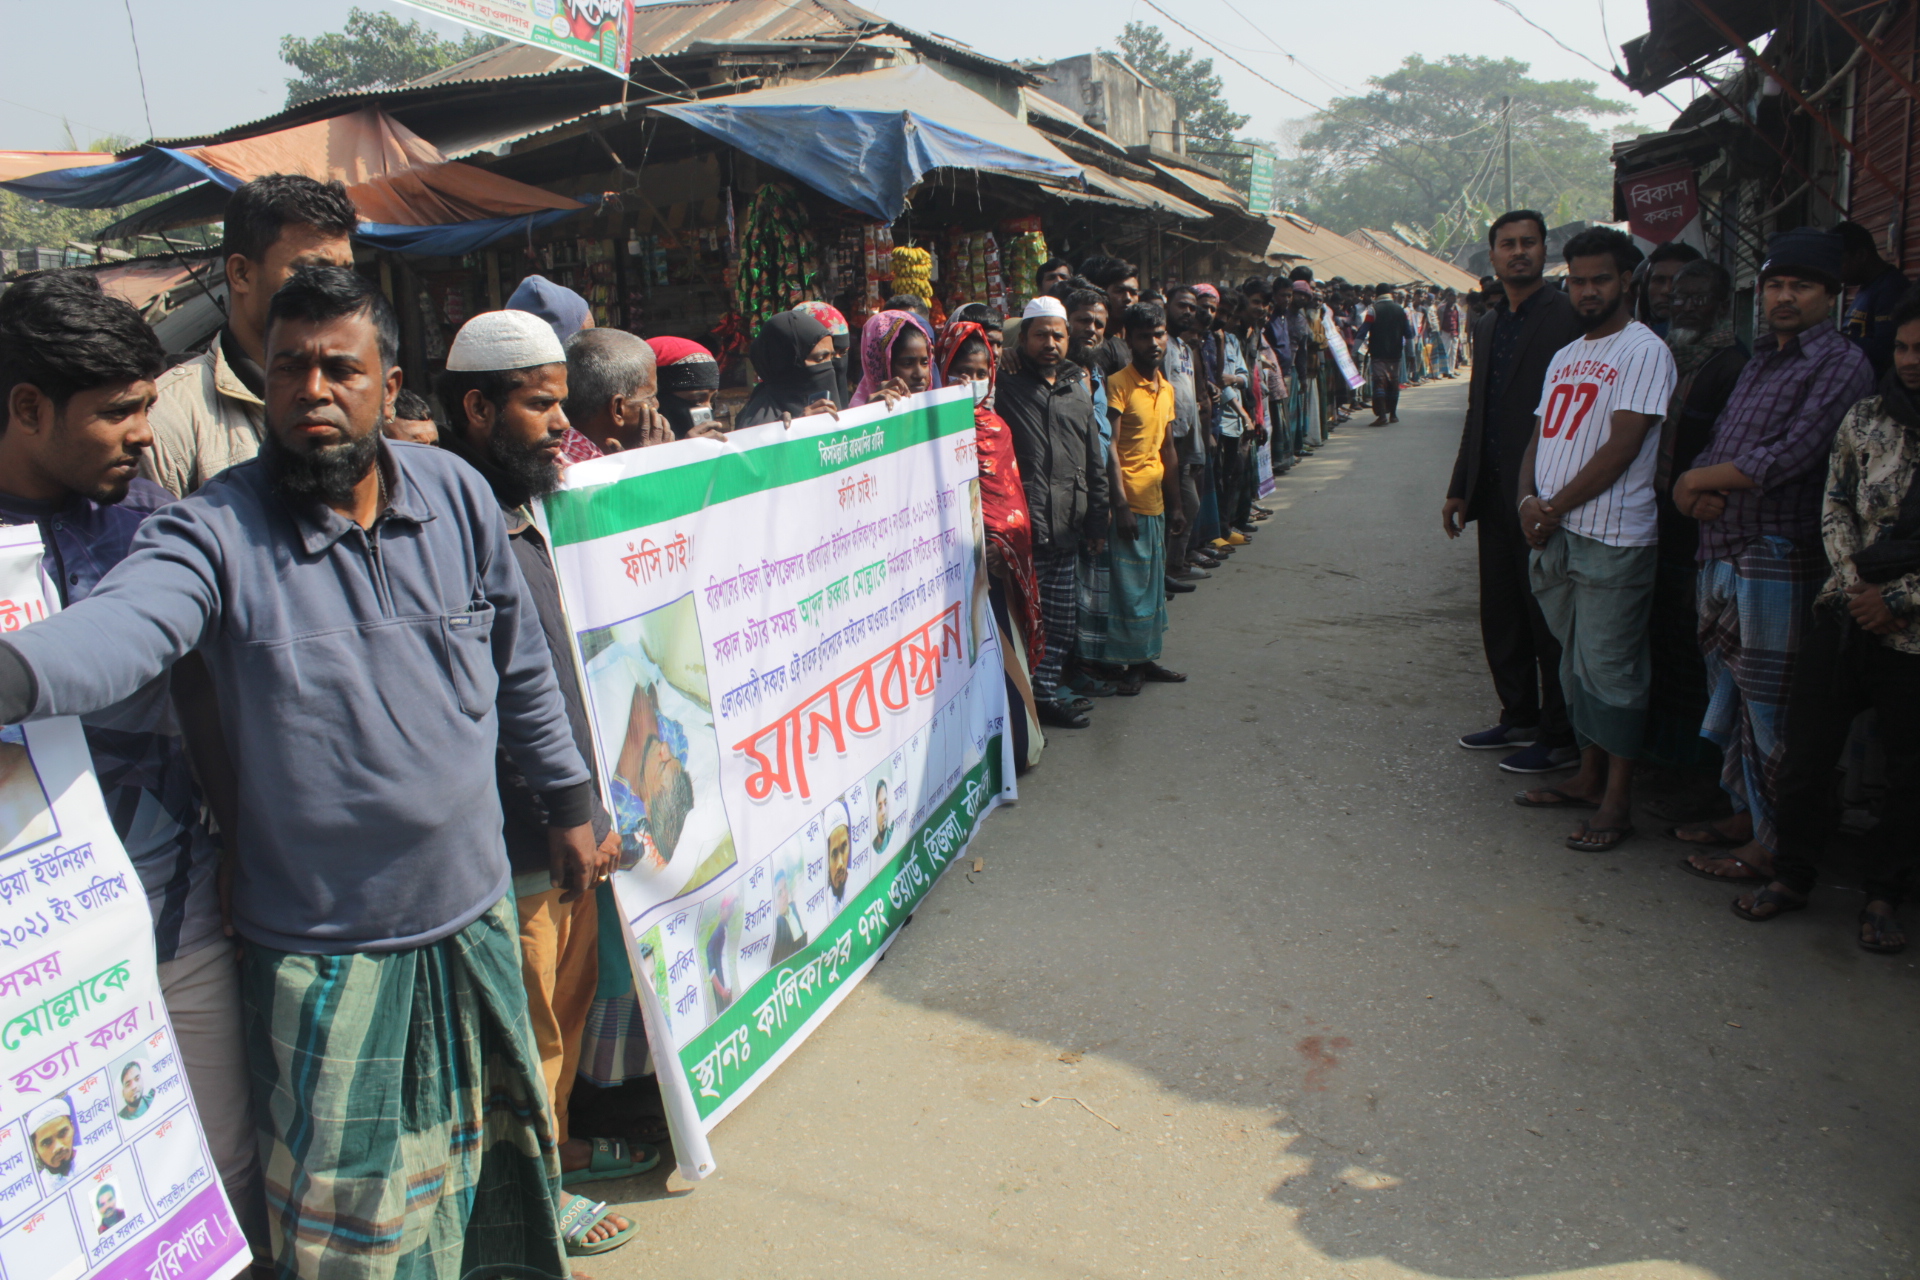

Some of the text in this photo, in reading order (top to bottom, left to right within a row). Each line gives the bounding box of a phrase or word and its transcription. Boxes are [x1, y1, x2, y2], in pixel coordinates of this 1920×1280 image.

[1630, 179, 1689, 208] বিকাশ
[1643, 205, 1684, 225] করুন
[1551, 360, 1619, 386] SWAGGER
[1542, 382, 1599, 441] 07
[838, 475, 856, 512] ফাঁসি
[620, 530, 695, 587] ফাঁসি চাই!!
[704, 574, 740, 613] বরিশালের
[738, 563, 764, 601] হিজলা
[760, 553, 805, 588] উপজেলার
[713, 631, 742, 667] সকাল
[743, 616, 770, 653] ৯টার
[769, 608, 798, 640] সময়
[825, 574, 850, 611] জব্বার
[853, 558, 886, 598] মোল্লাকে
[720, 667, 762, 718] এলাকাবাসী
[761, 664, 788, 698] সকলে
[789, 650, 801, 685] এই
[732, 600, 962, 800] মানববন্ধন
[850, 785, 862, 805] খুনি
[806, 820, 819, 842] খুনি
[28, 841, 96, 887] ইউনিয়ন
[749, 866, 764, 889] খুনি
[808, 856, 823, 882] ইমাম
[47, 897, 78, 925] ইং
[73, 871, 128, 910] তারিখে
[806, 887, 825, 914] সরদার
[666, 912, 690, 936] খুনি
[740, 934, 770, 961] সরদার
[751, 928, 853, 1038] কালিকাপুর
[859, 898, 889, 945] ৭নং
[887, 840, 930, 910] ওয়ার্ড,
[668, 948, 696, 984] রাকিব
[2, 959, 130, 1051] মোল্লাকে
[675, 984, 698, 1016] বালি
[8, 1041, 79, 1093] হত্যা
[84, 1006, 139, 1050] করে
[149, 1032, 164, 1048] খুনি
[78, 1076, 98, 1094] খুনি
[156, 1073, 179, 1095] সরদার
[77, 1096, 110, 1123] ইব্রাহিম
[83, 1119, 114, 1145] সরদার
[155, 1120, 173, 1139] খুনি
[93, 1163, 112, 1183] খুনি
[22, 1212, 45, 1233] খুনি
[91, 1213, 145, 1257] কবির সরদার
